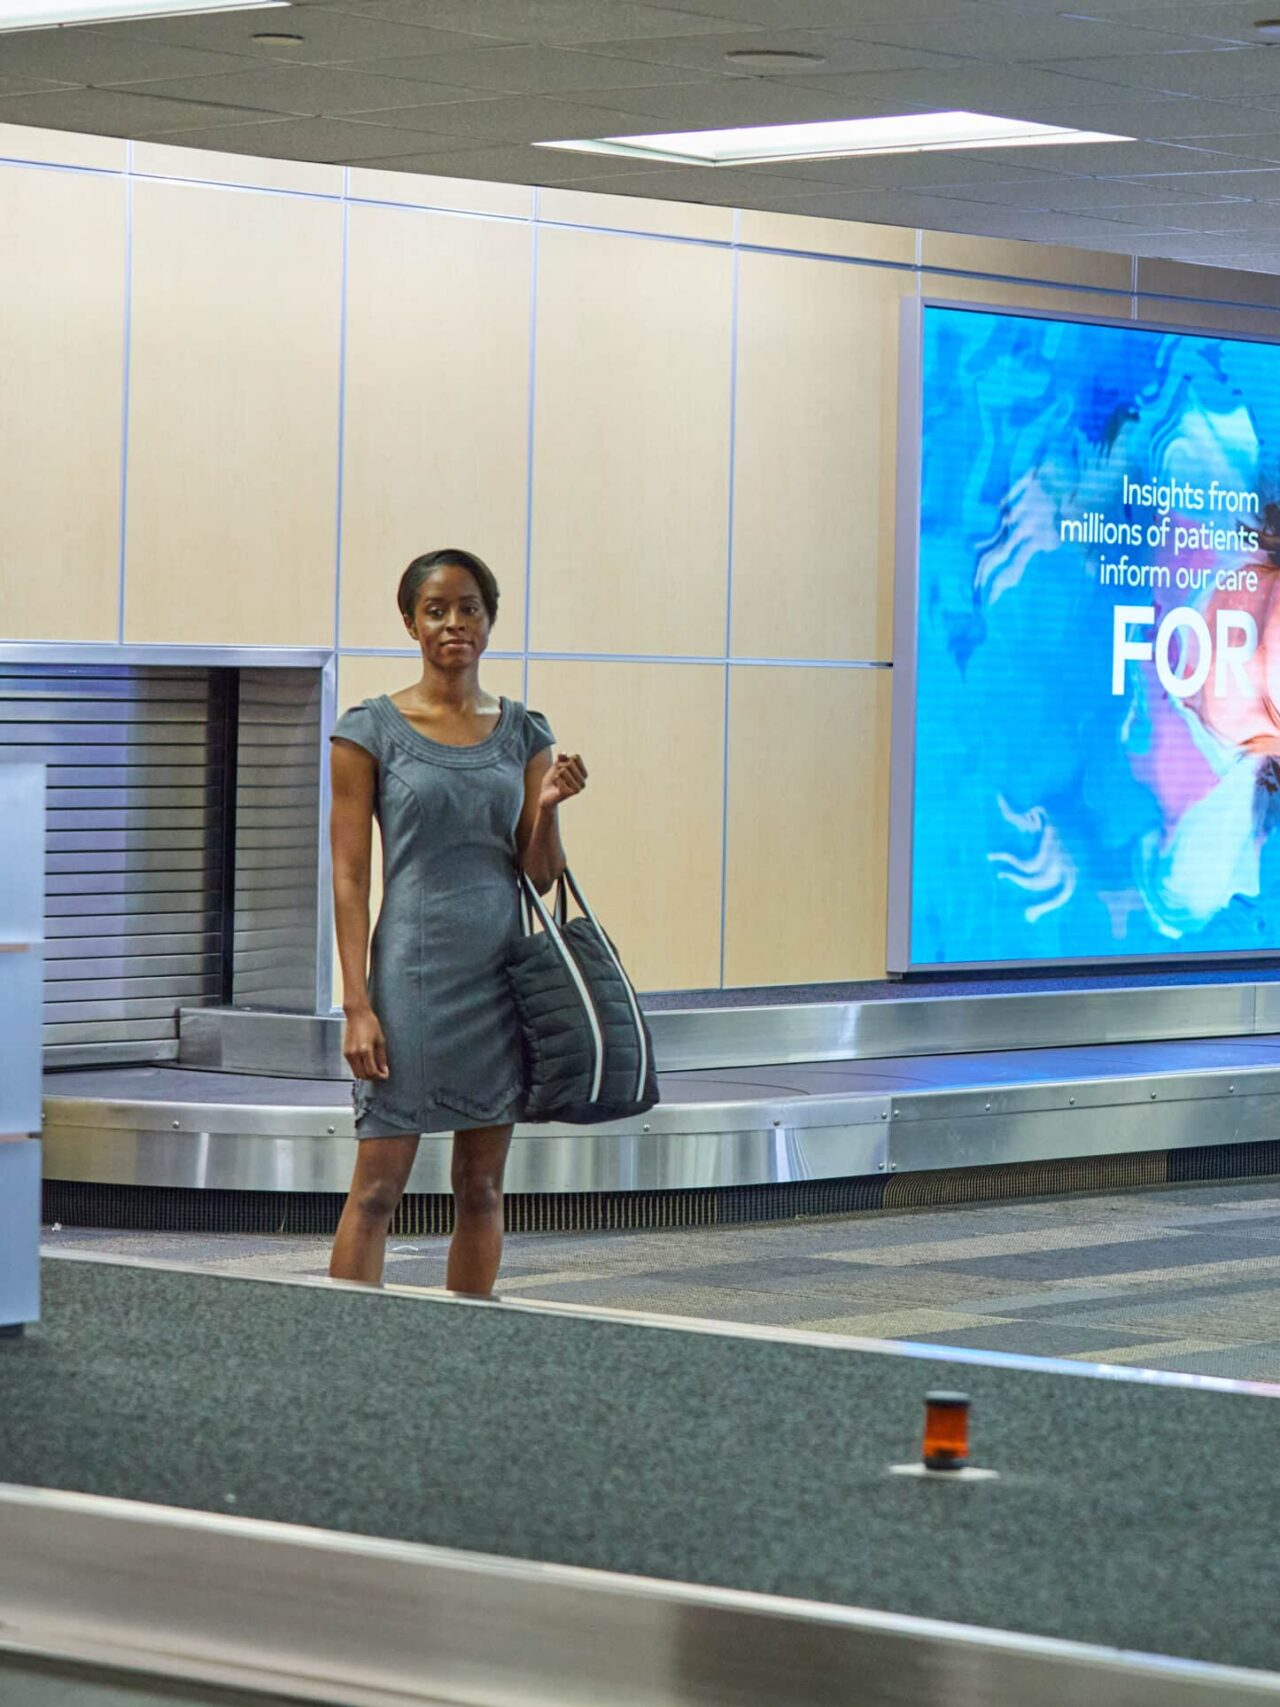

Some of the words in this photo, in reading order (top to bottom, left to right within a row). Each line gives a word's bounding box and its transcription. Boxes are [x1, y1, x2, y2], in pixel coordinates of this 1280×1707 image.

[1123, 474, 1204, 515] Insights
[1208, 480, 1259, 513] from
[1060, 512, 1142, 546] millions
[1147, 518, 1171, 547] of
[1174, 521, 1259, 555] patients
[1100, 555, 1170, 588] inform
[1176, 566, 1211, 589] our
[1215, 569, 1258, 592] care
[1112, 605, 1258, 698] FOR
